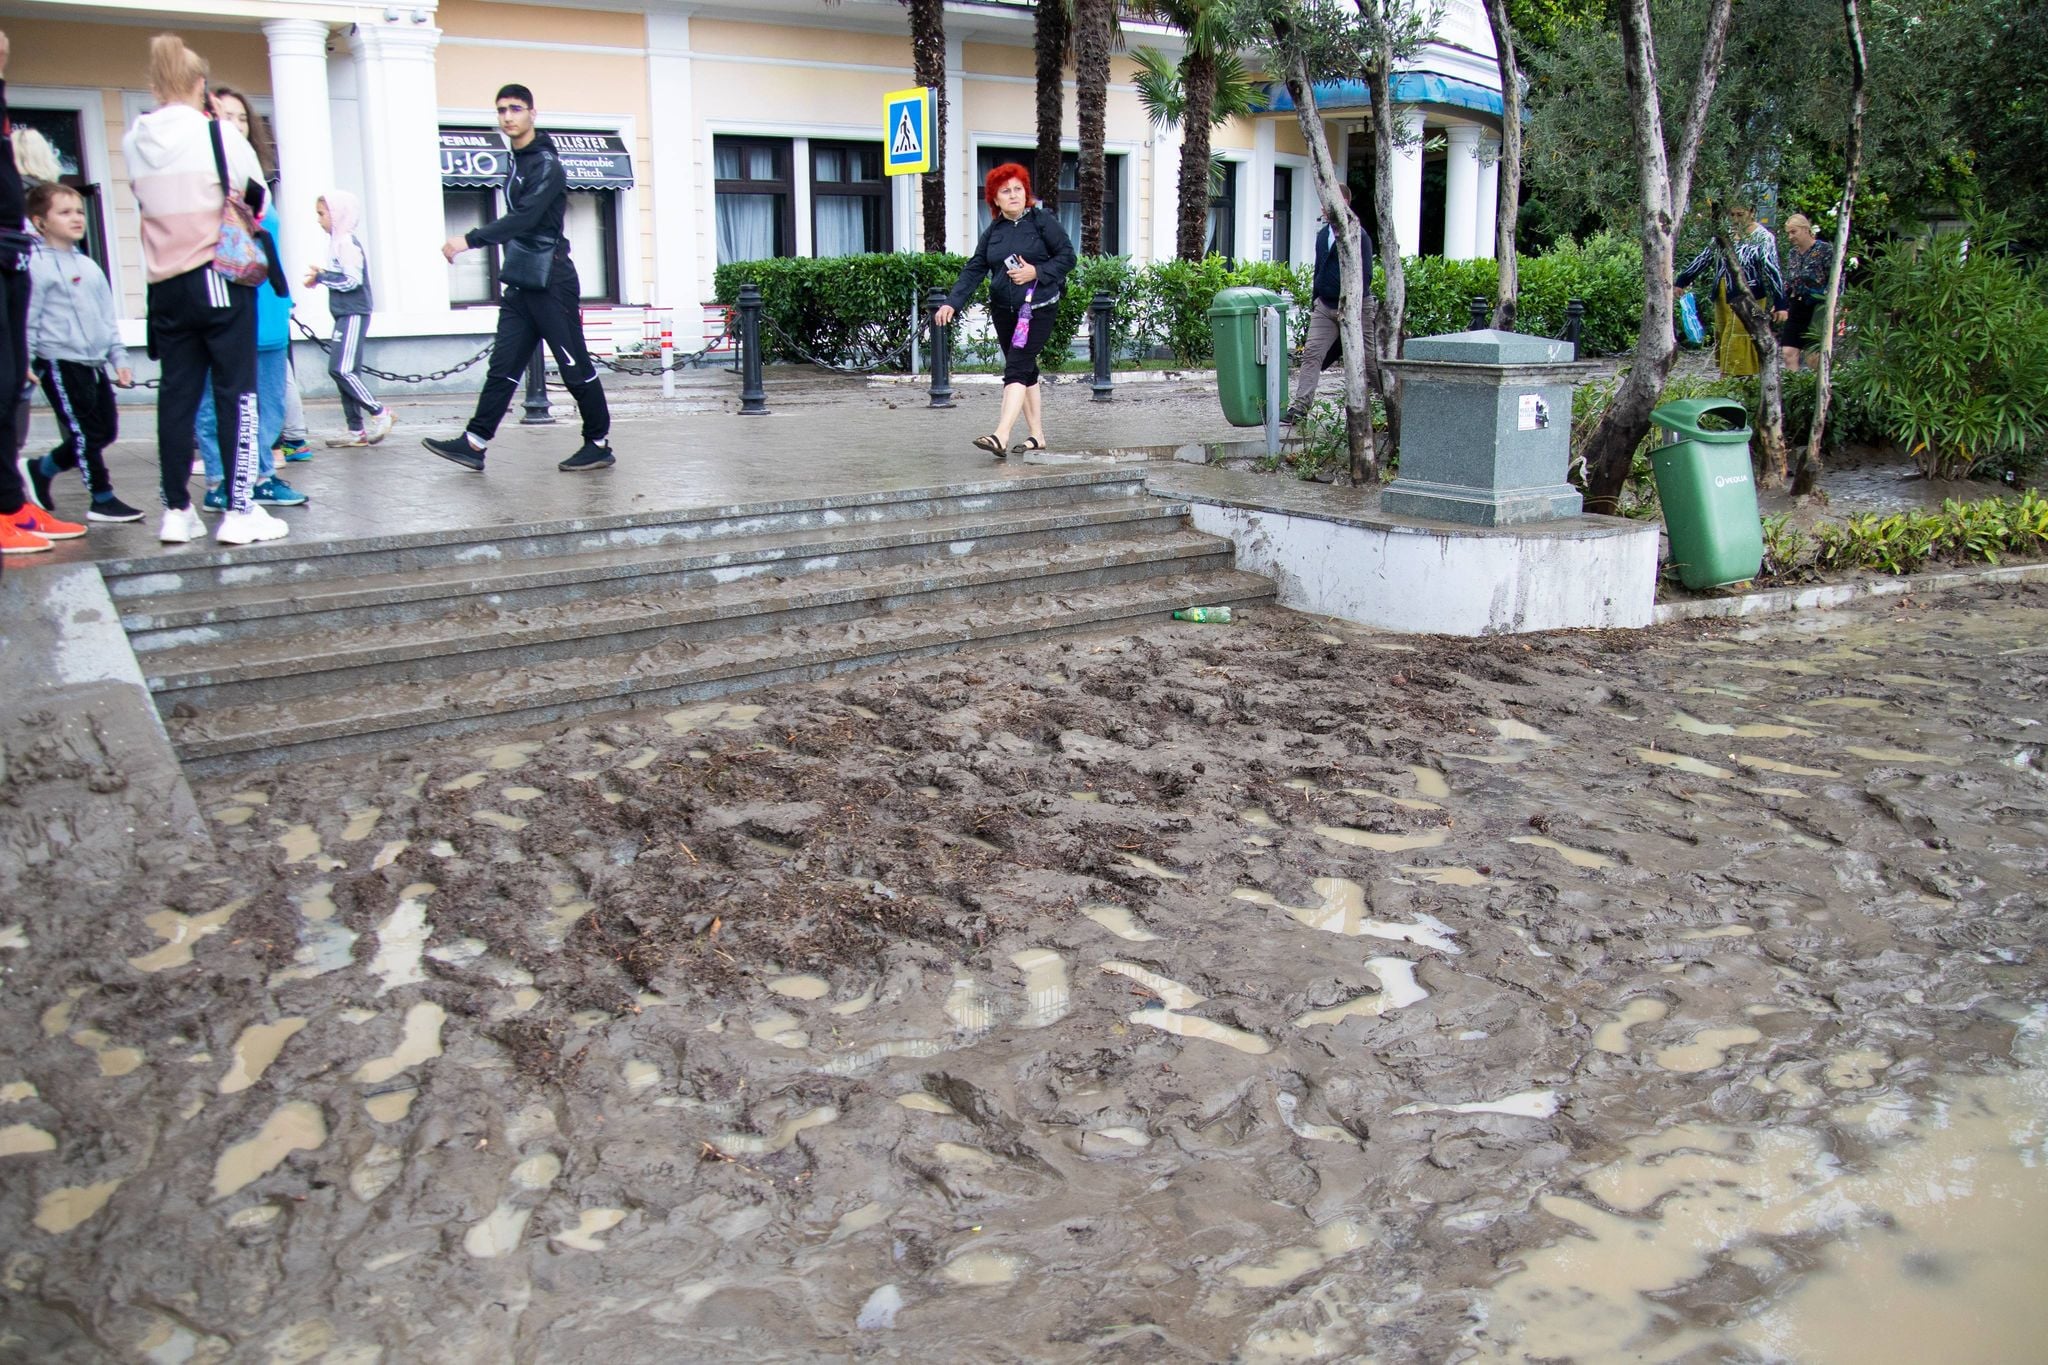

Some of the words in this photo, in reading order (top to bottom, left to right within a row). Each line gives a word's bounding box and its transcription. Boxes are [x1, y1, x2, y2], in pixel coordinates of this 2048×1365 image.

[550, 136, 608, 149] OLLISTER
[558, 156, 615, 168] bercrombie
[576, 167, 604, 177] Fitch
